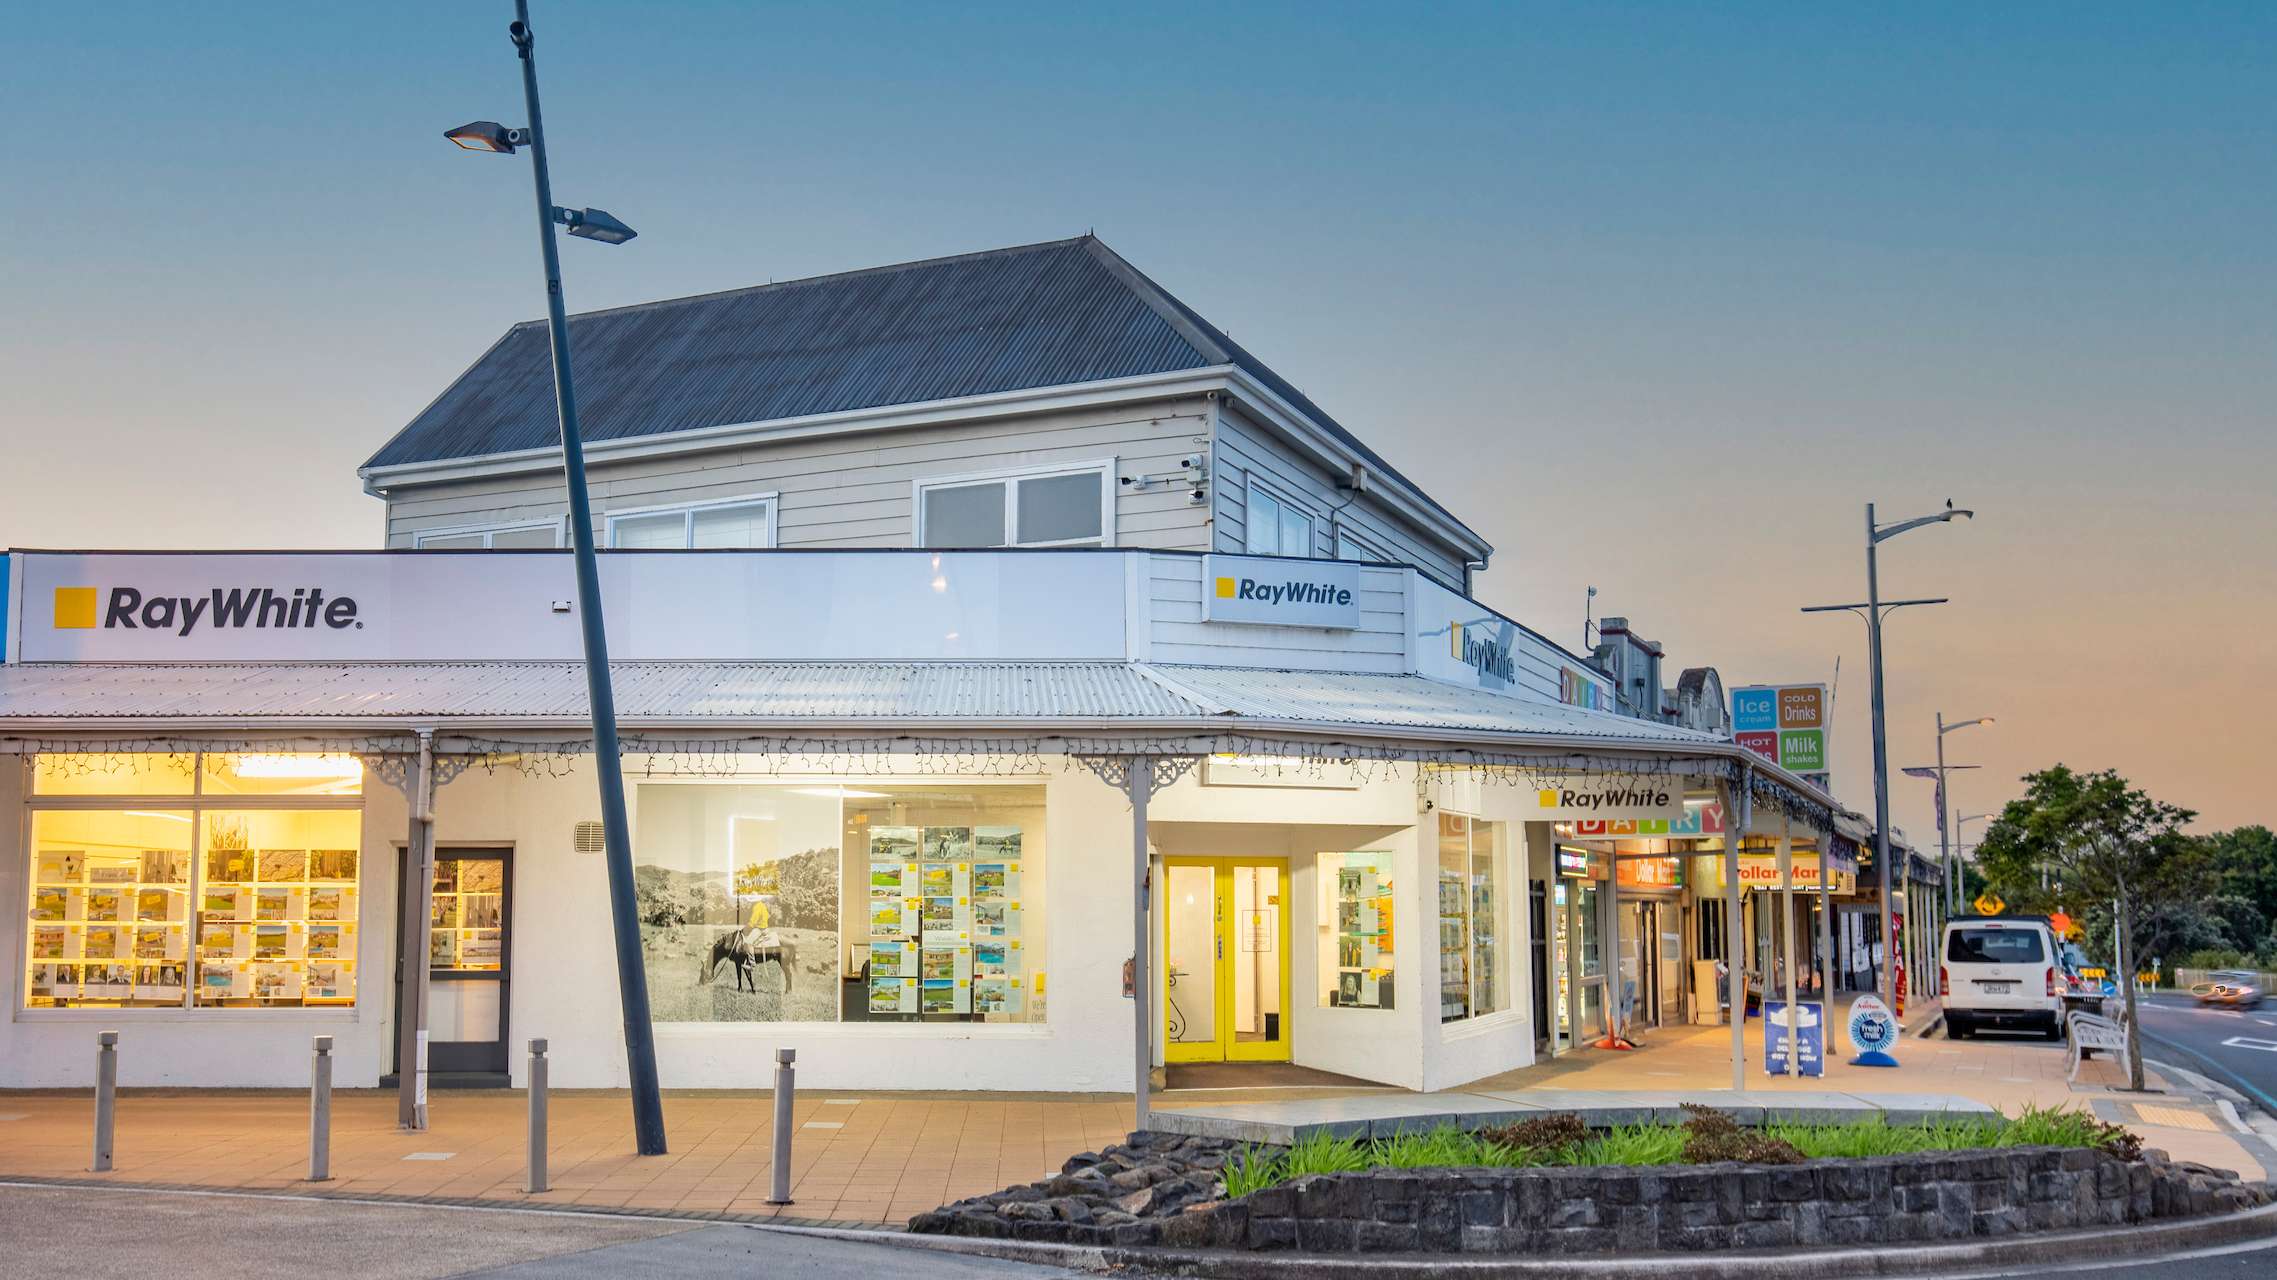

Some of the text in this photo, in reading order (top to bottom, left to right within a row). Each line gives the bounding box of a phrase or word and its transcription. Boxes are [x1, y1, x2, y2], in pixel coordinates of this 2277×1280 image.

[1740, 698, 1771, 714] Ice
[1784, 694, 1816, 703] COLD
[1784, 704, 1817, 721] Drinks
[1785, 736, 1818, 754] Milk
[1785, 754, 1818, 765] shakes
[1737, 865, 1820, 880] ollar Mar
